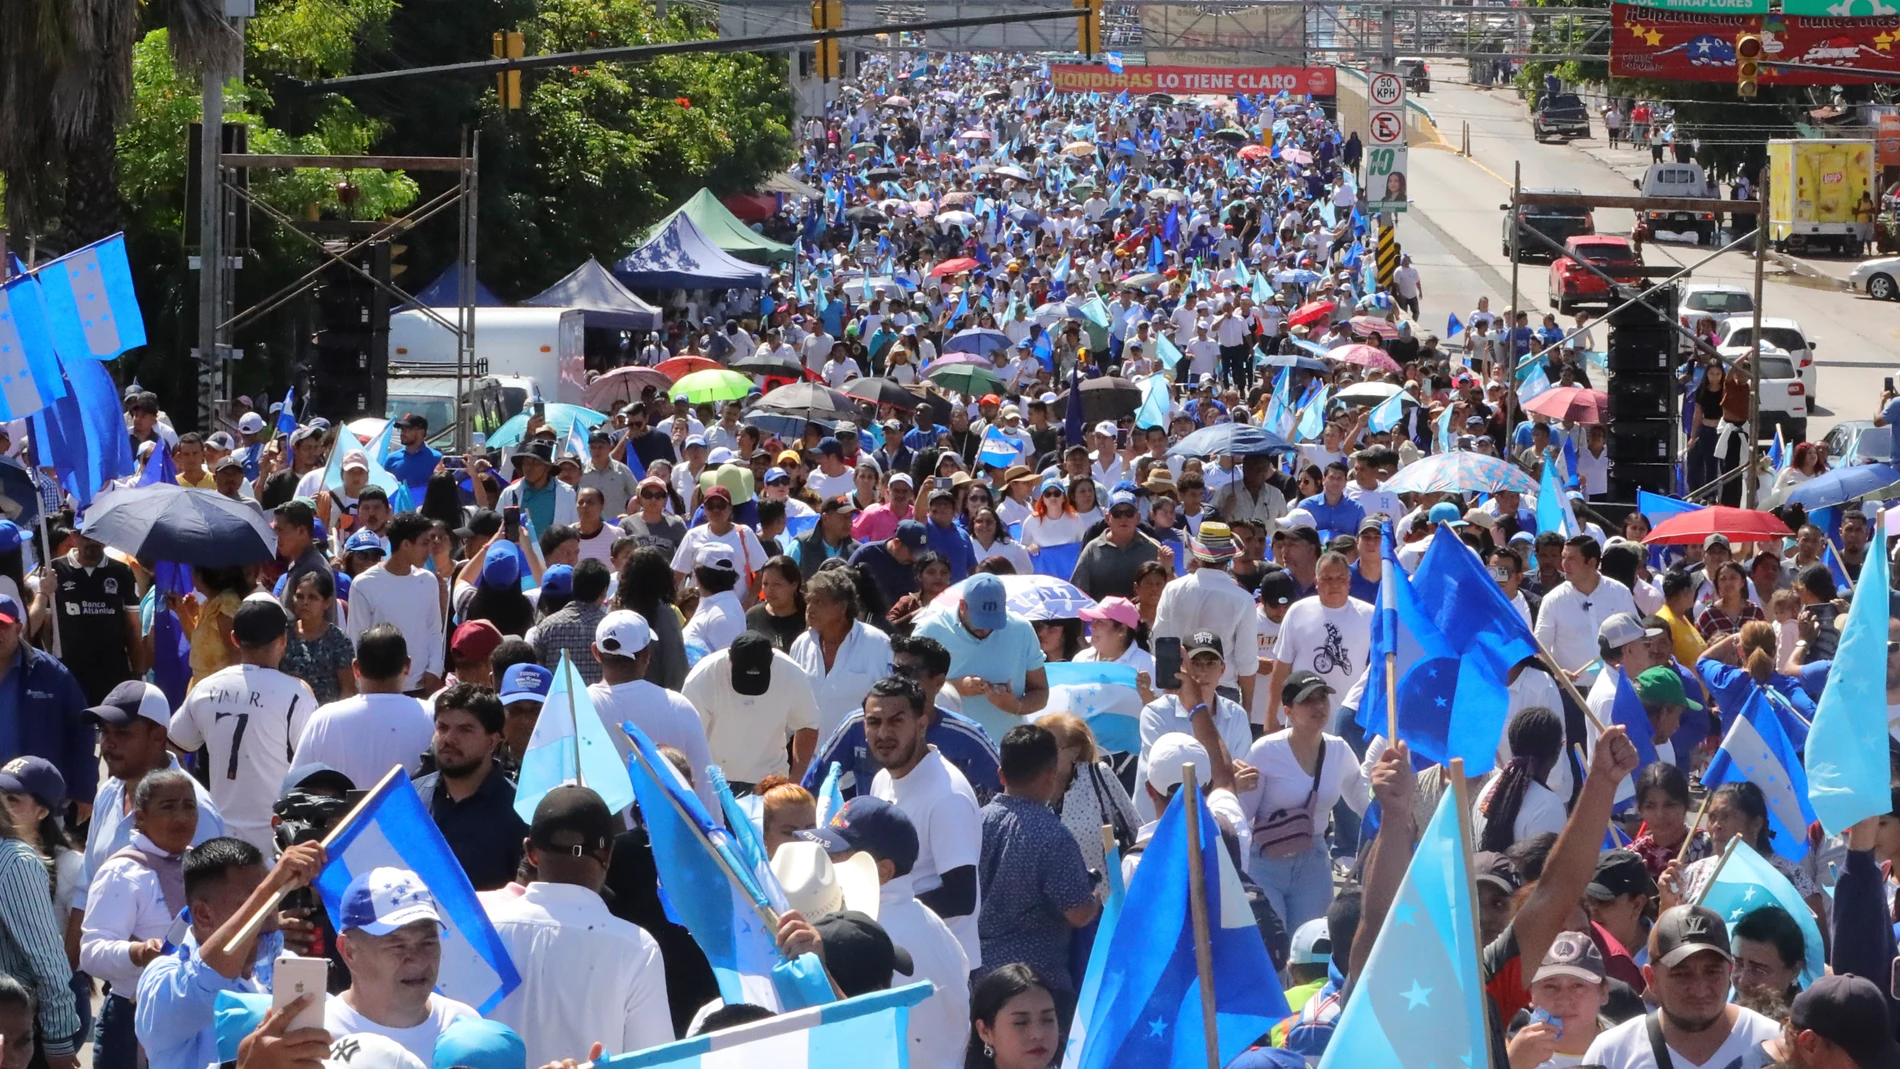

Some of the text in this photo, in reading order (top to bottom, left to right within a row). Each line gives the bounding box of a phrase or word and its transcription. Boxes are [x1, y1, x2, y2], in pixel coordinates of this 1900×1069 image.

[1667, 0, 1753, 8] MIRAFLORES
[1051, 73, 1297, 89] HONDURAS LO TIENE CLARO
[1381, 78, 1392, 87] 50
[1376, 88, 1396, 98] KPH
[1369, 148, 1395, 176] 10
[82, 600, 106, 608] Banco
[249, 691, 264, 708] R.
[215, 711, 249, 781] 7
[803, 831, 831, 848] CHILE
